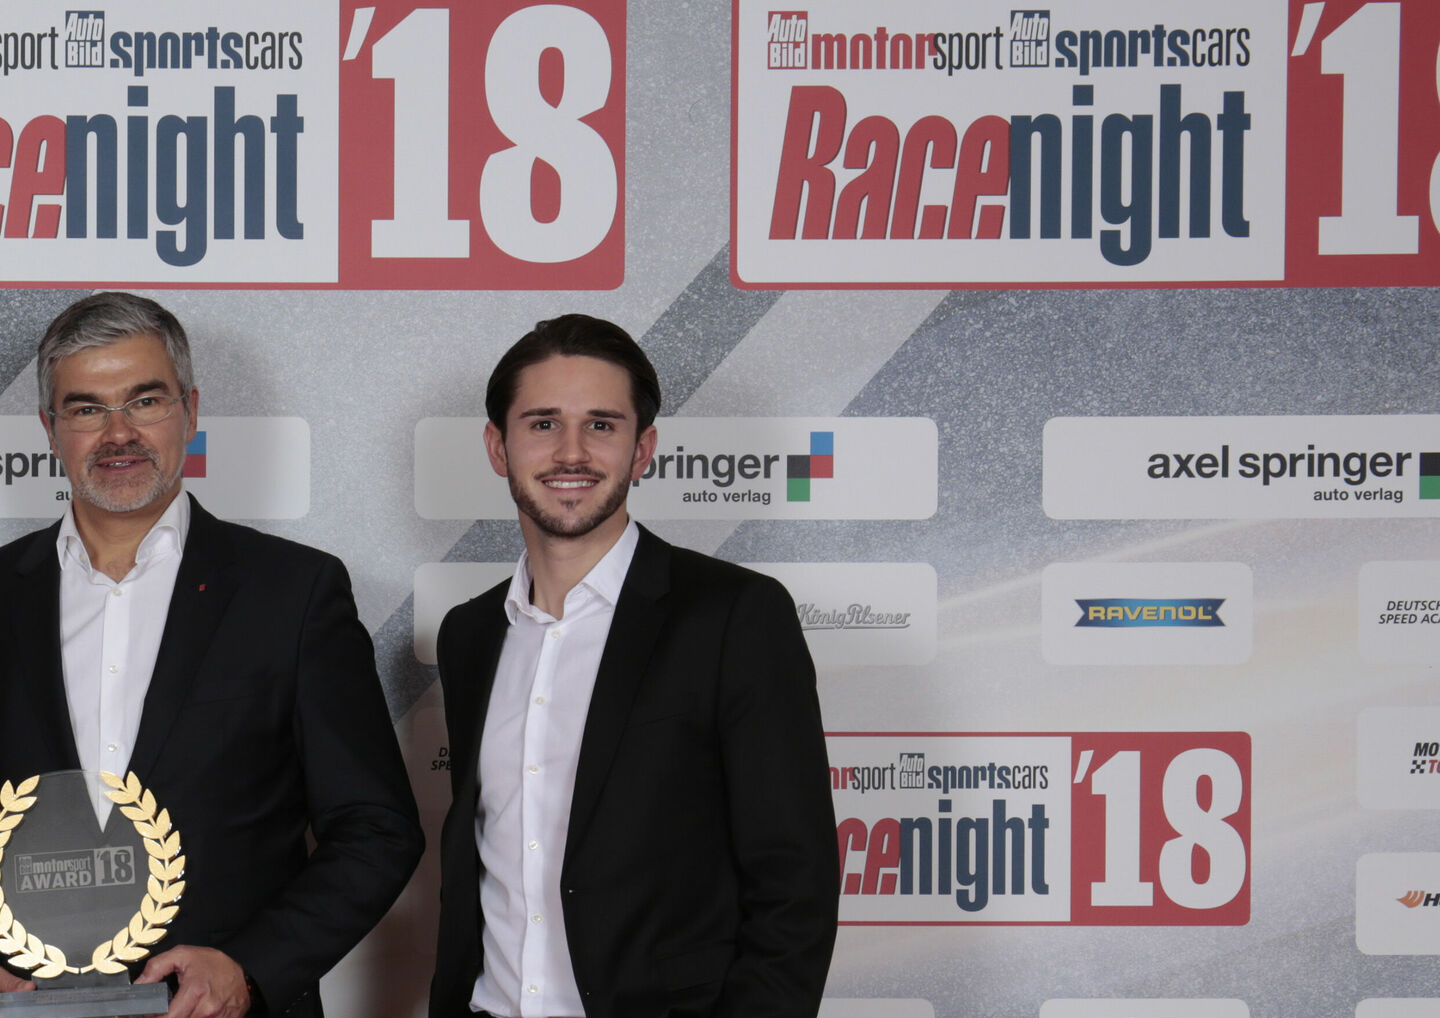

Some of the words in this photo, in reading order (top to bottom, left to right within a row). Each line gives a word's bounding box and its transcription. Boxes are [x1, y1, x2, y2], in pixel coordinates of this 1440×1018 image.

[66, 12, 104, 41] Auto
[768, 12, 807, 42] Auto
[1010, 11, 1049, 41] Auto
[67, 41, 103, 67] Bild
[110, 26, 303, 77] sportscars
[769, 42, 806, 68] Bild
[812, 26, 1004, 76] motorsport
[1012, 41, 1048, 66] Bild
[1055, 24, 1251, 76] sportscars
[1291, 0, 1440, 256] '1
[768, 83, 1252, 267] Racenight
[1147, 445, 1229, 479] axel
[1238, 444, 1412, 486] springer
[682, 489, 718, 503] auto
[722, 489, 772, 505] verlag
[1313, 489, 1349, 502] auto
[1354, 488, 1404, 503] verlag
[1087, 606, 1212, 621] RAVENOL
[1378, 613, 1418, 625] SPEED
[900, 754, 924, 773] Auto
[927, 762, 1049, 794] sportscars
[901, 773, 924, 789] Bild
[836, 799, 1049, 912] cenight
[20, 870, 92, 891] AWARD
